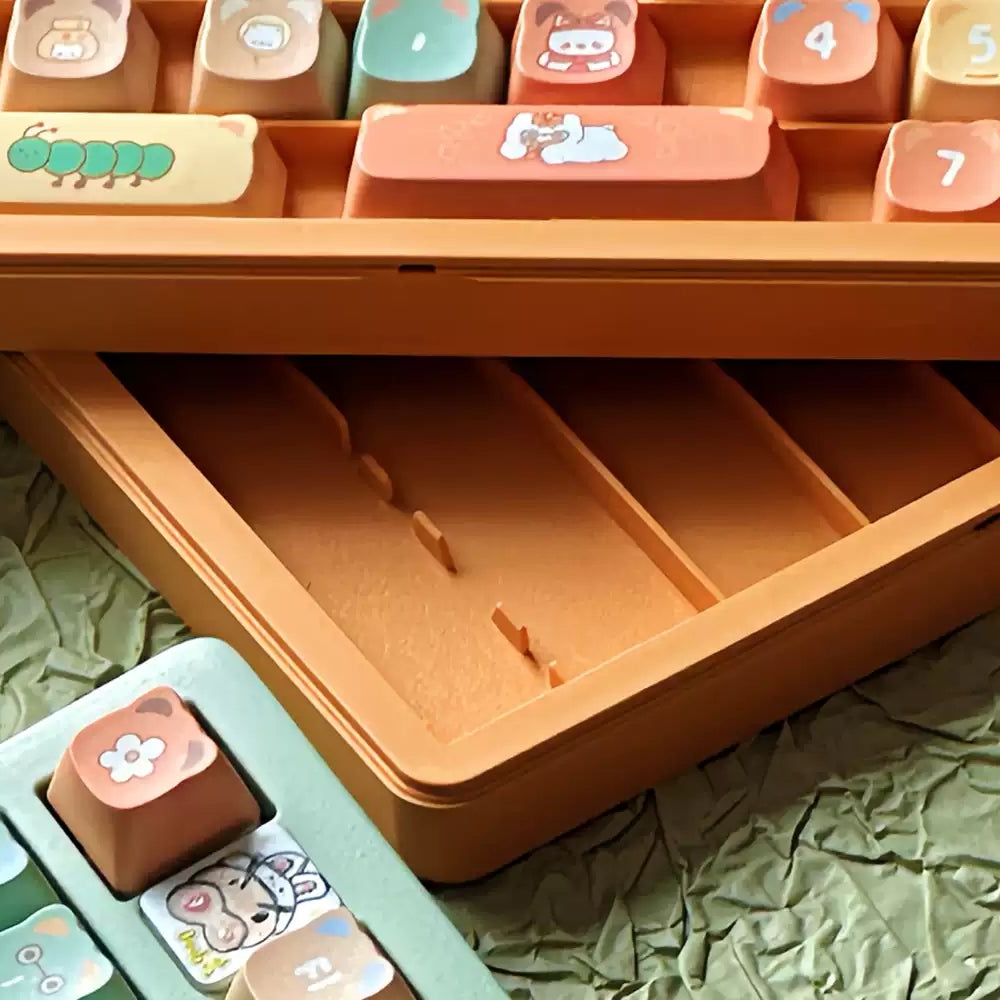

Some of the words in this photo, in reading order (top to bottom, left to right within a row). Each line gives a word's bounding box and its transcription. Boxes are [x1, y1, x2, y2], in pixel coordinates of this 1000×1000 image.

[804, 21, 837, 60] 4
[968, 24, 997, 64] 5
[937, 149, 965, 187] 7
